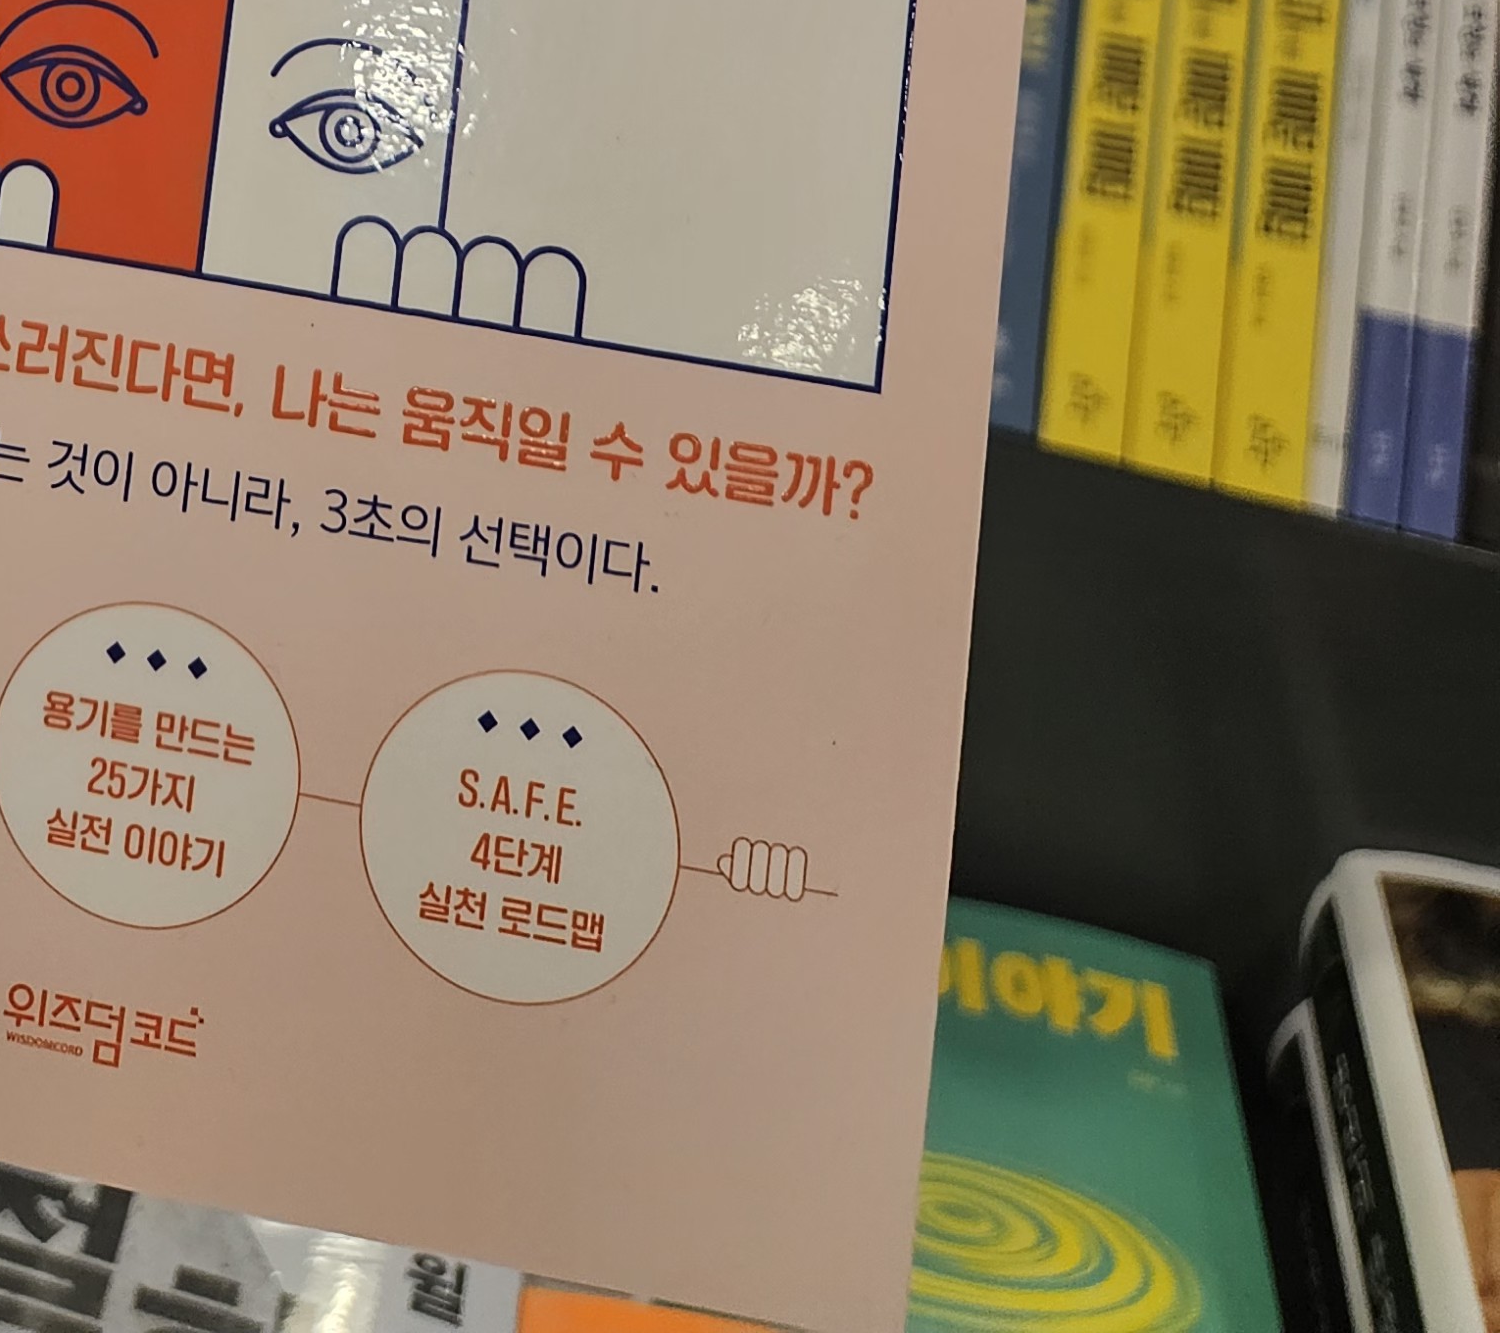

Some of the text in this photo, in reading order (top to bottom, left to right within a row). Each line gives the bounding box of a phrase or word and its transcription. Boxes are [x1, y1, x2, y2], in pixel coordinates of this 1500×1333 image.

[271, 363, 381, 439] 나는
[401, 386, 571, 473] 움직일
[588, 422, 645, 482] 수
[665, 432, 874, 520] 있을까?
[47, 439, 135, 503] 것이
[151, 461, 300, 538] 아니라,
[319, 488, 443, 559] 3초의
[458, 514, 661, 595] 선택이다.
[43, 690, 255, 766] 용기를 만드는
[87, 756, 196, 814] 25가지
[458, 768, 582, 827] S.A.F.E.
[46, 807, 226, 879] 실전 이야기
[470, 832, 563, 884] 4단계
[418, 881, 605, 954] 실천 로드맵
[3, 983, 204, 1068] 위즈덤코드
